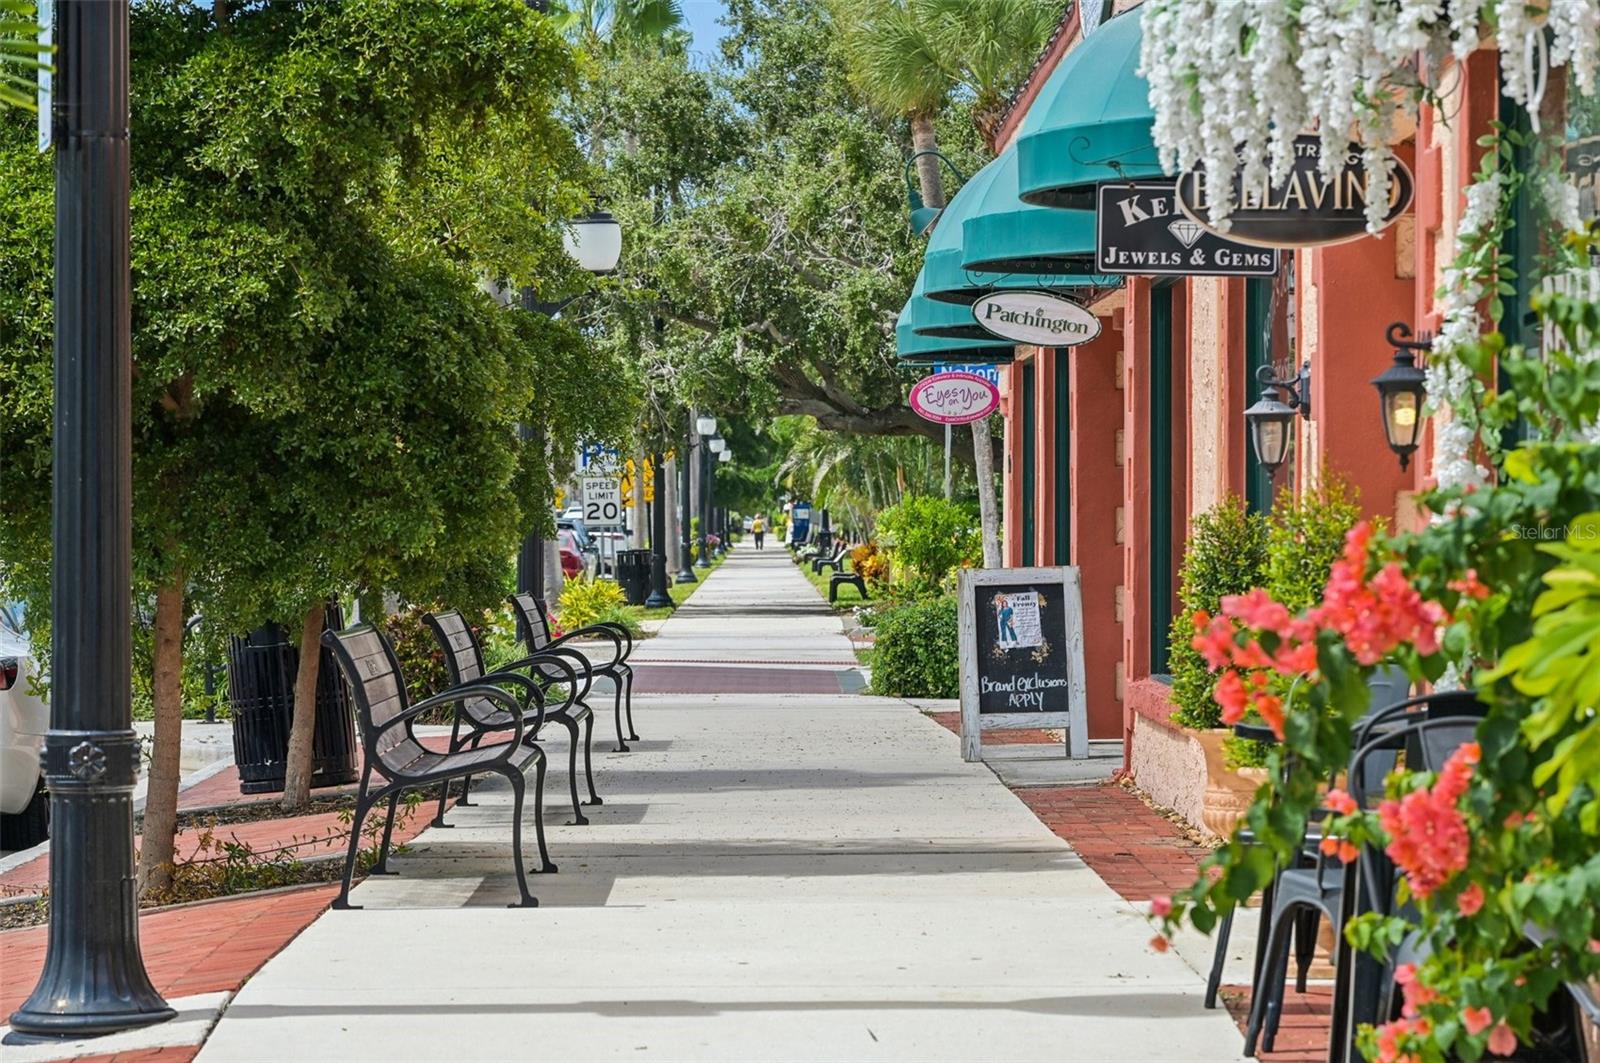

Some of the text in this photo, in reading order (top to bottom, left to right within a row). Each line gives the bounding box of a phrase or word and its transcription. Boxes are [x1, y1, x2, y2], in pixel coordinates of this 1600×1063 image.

[1193, 170, 1401, 211] BLLAVIN
[1104, 247, 1271, 268] JEWELS & GEMS
[985, 303, 1088, 334] Patchington
[923, 385, 988, 410] Eyes on You
[588, 492, 614, 500] LIMIT
[586, 502, 618, 520] 20
[981, 675, 1015, 694] Brand
[1008, 690, 1045, 711] APPLY
